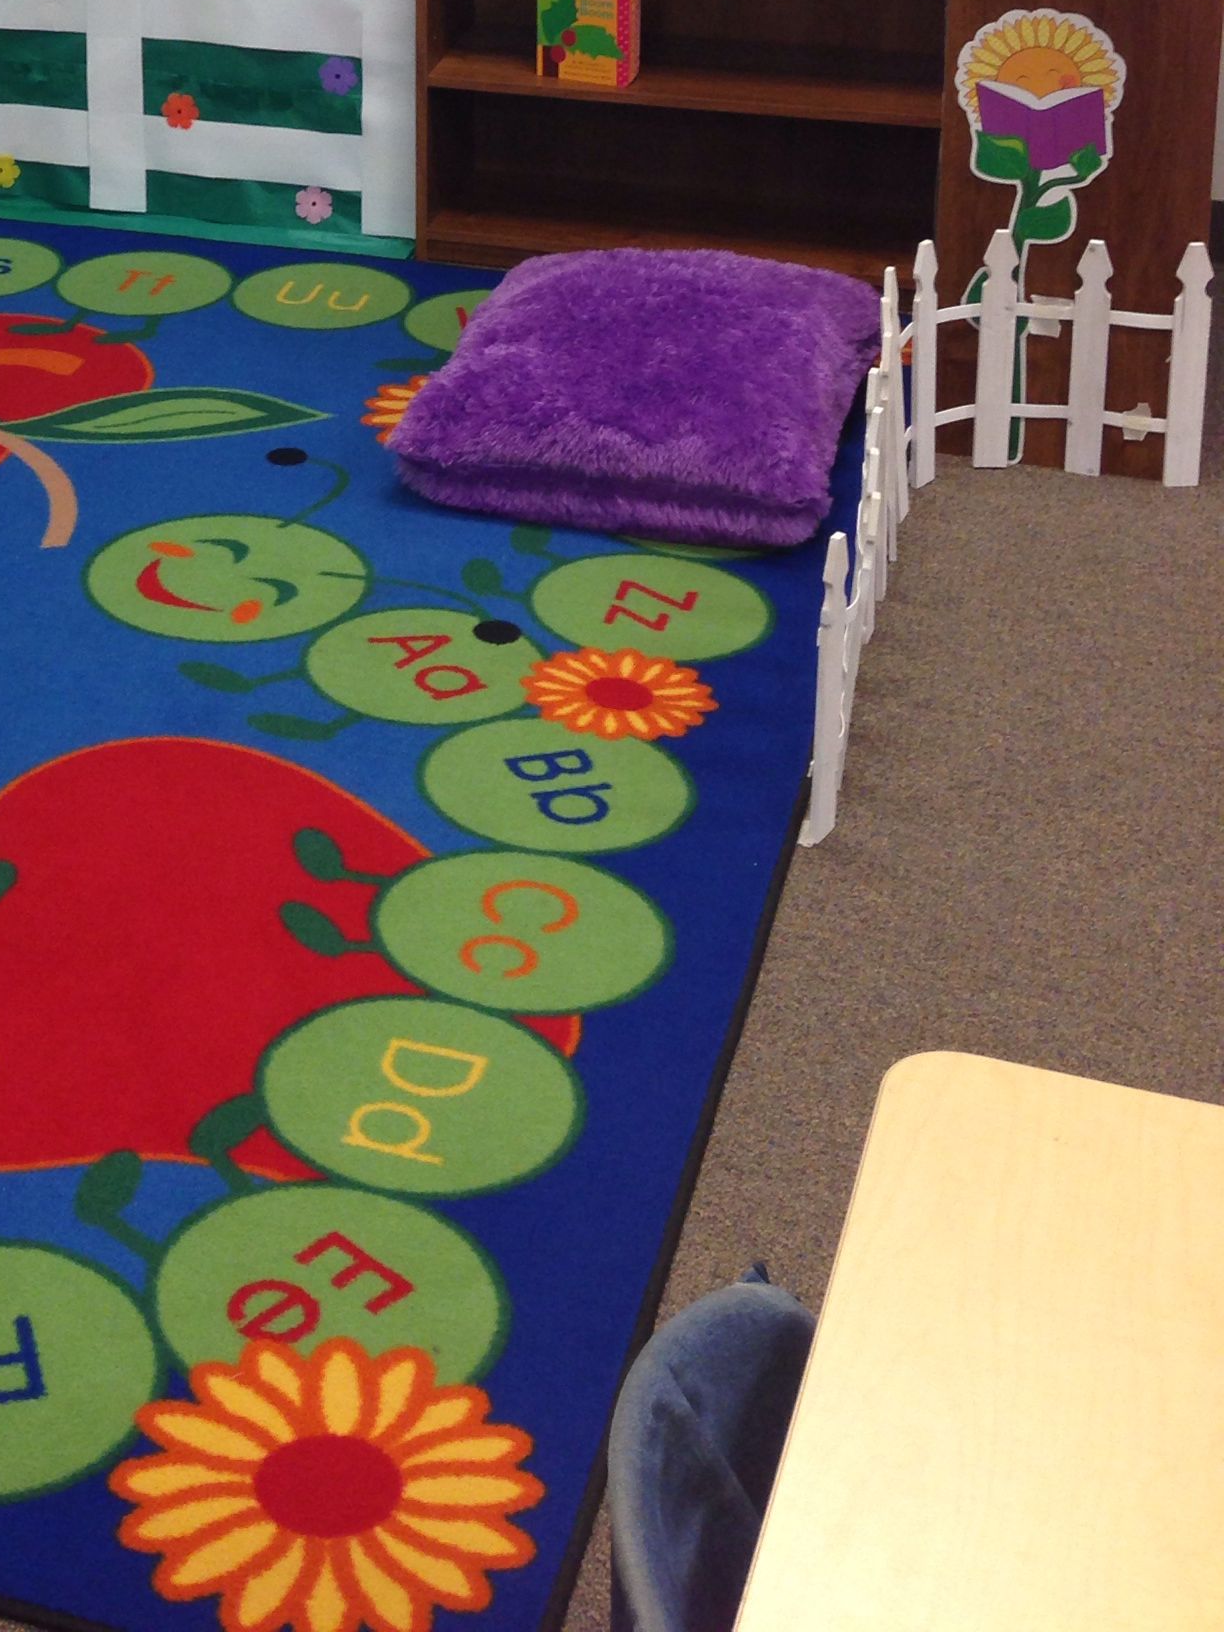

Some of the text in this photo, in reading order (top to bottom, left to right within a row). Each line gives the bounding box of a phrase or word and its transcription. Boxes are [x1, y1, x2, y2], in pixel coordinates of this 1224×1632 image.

[118, 270, 176, 296] Tt
[277, 280, 370, 311] Uu
[604, 579, 698, 632] Zz
[367, 634, 488, 700] Aa
[505, 748, 613, 826] Bb
[459, 879, 579, 979] Cc
[341, 1037, 489, 1166] Dd
[227, 1230, 416, 1345] Ee
